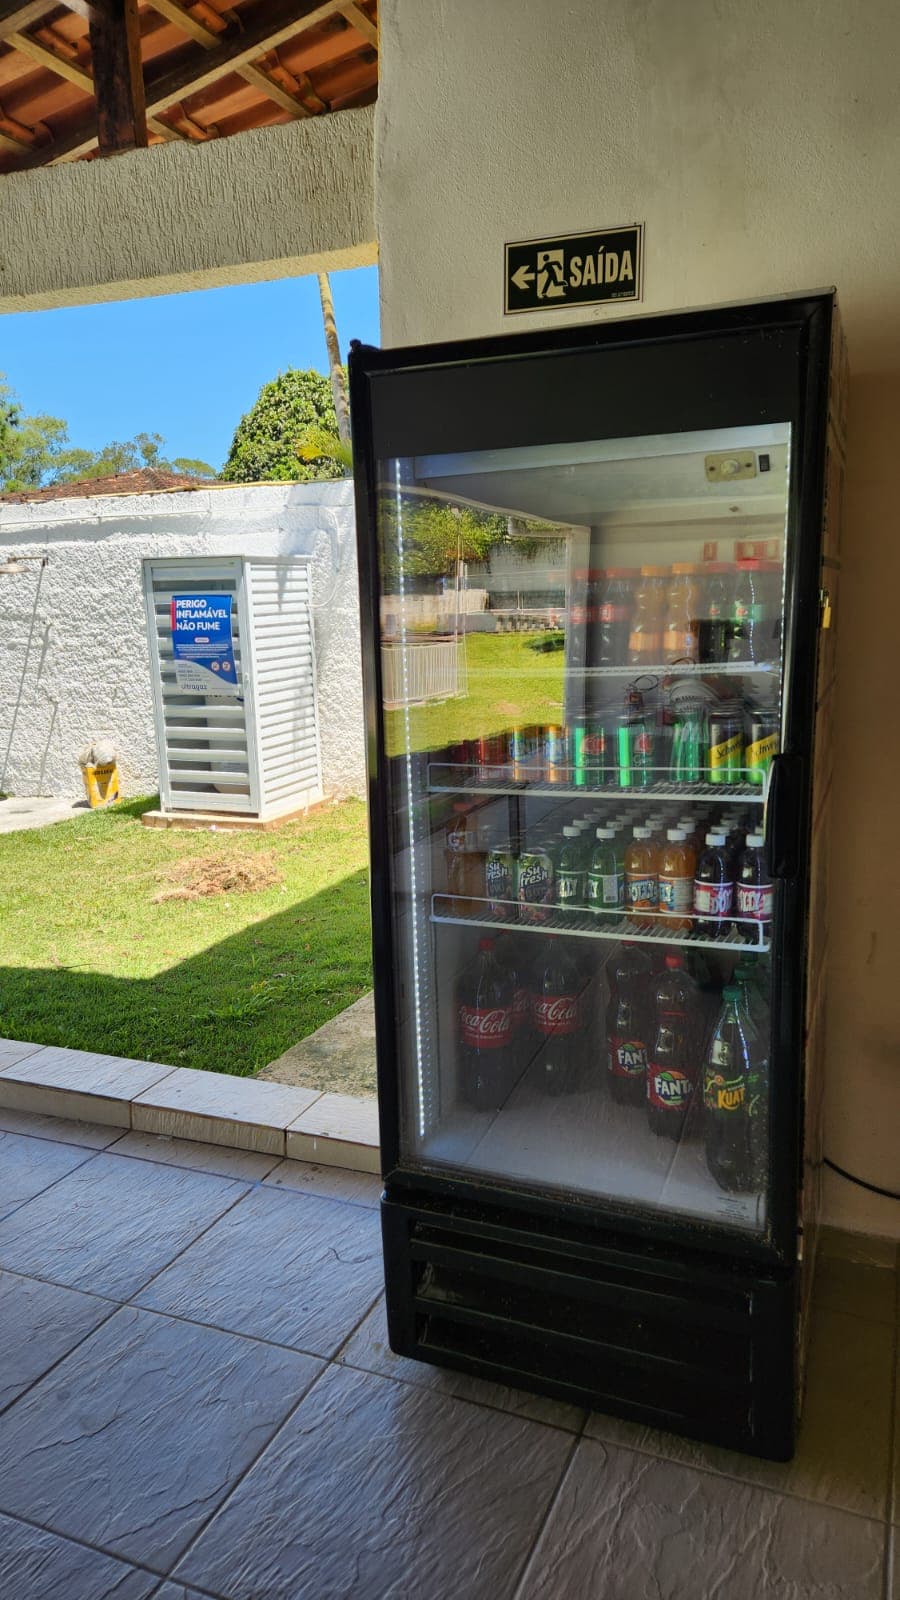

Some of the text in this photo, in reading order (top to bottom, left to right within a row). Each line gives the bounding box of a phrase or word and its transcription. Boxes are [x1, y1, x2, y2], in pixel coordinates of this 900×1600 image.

[569, 245, 634, 288] SAÍDA
[176, 599, 207, 609] PERIGO
[176, 607, 228, 619] INFLAMÁVEL
[176, 619, 221, 631] NÃO FUME
[718, 1087, 745, 1109] KUAT
